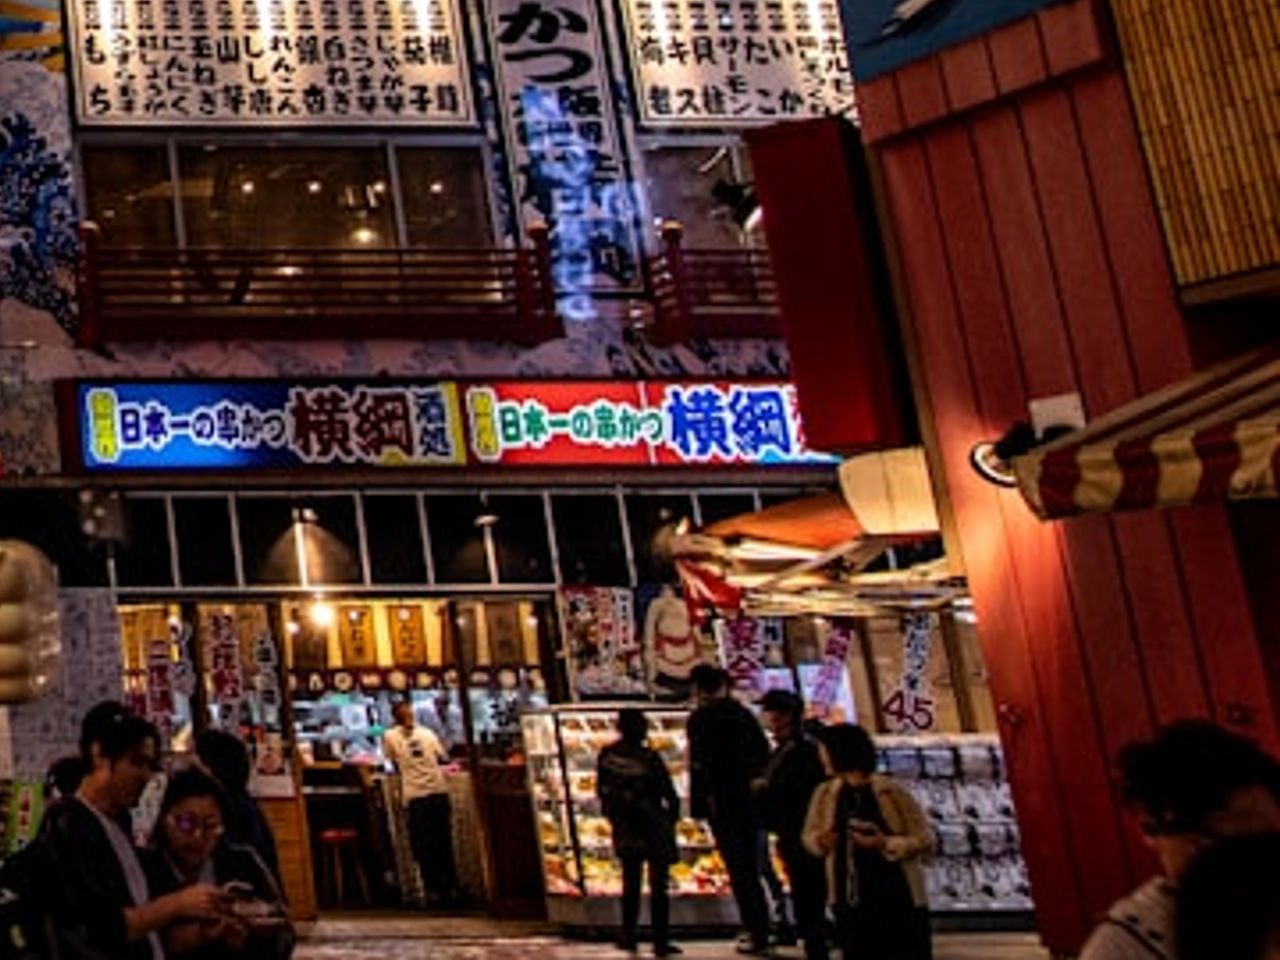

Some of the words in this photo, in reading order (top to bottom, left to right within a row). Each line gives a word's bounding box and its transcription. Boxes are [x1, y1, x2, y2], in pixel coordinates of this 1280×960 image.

[84, 34, 112, 114] もち
[668, 36, 701, 114] キス
[120, 400, 286, 448] 日本一の串かつ
[290, 390, 417, 458] 横綱
[499, 402, 665, 446] 日本一の串かつ
[668, 390, 794, 457] 横綱
